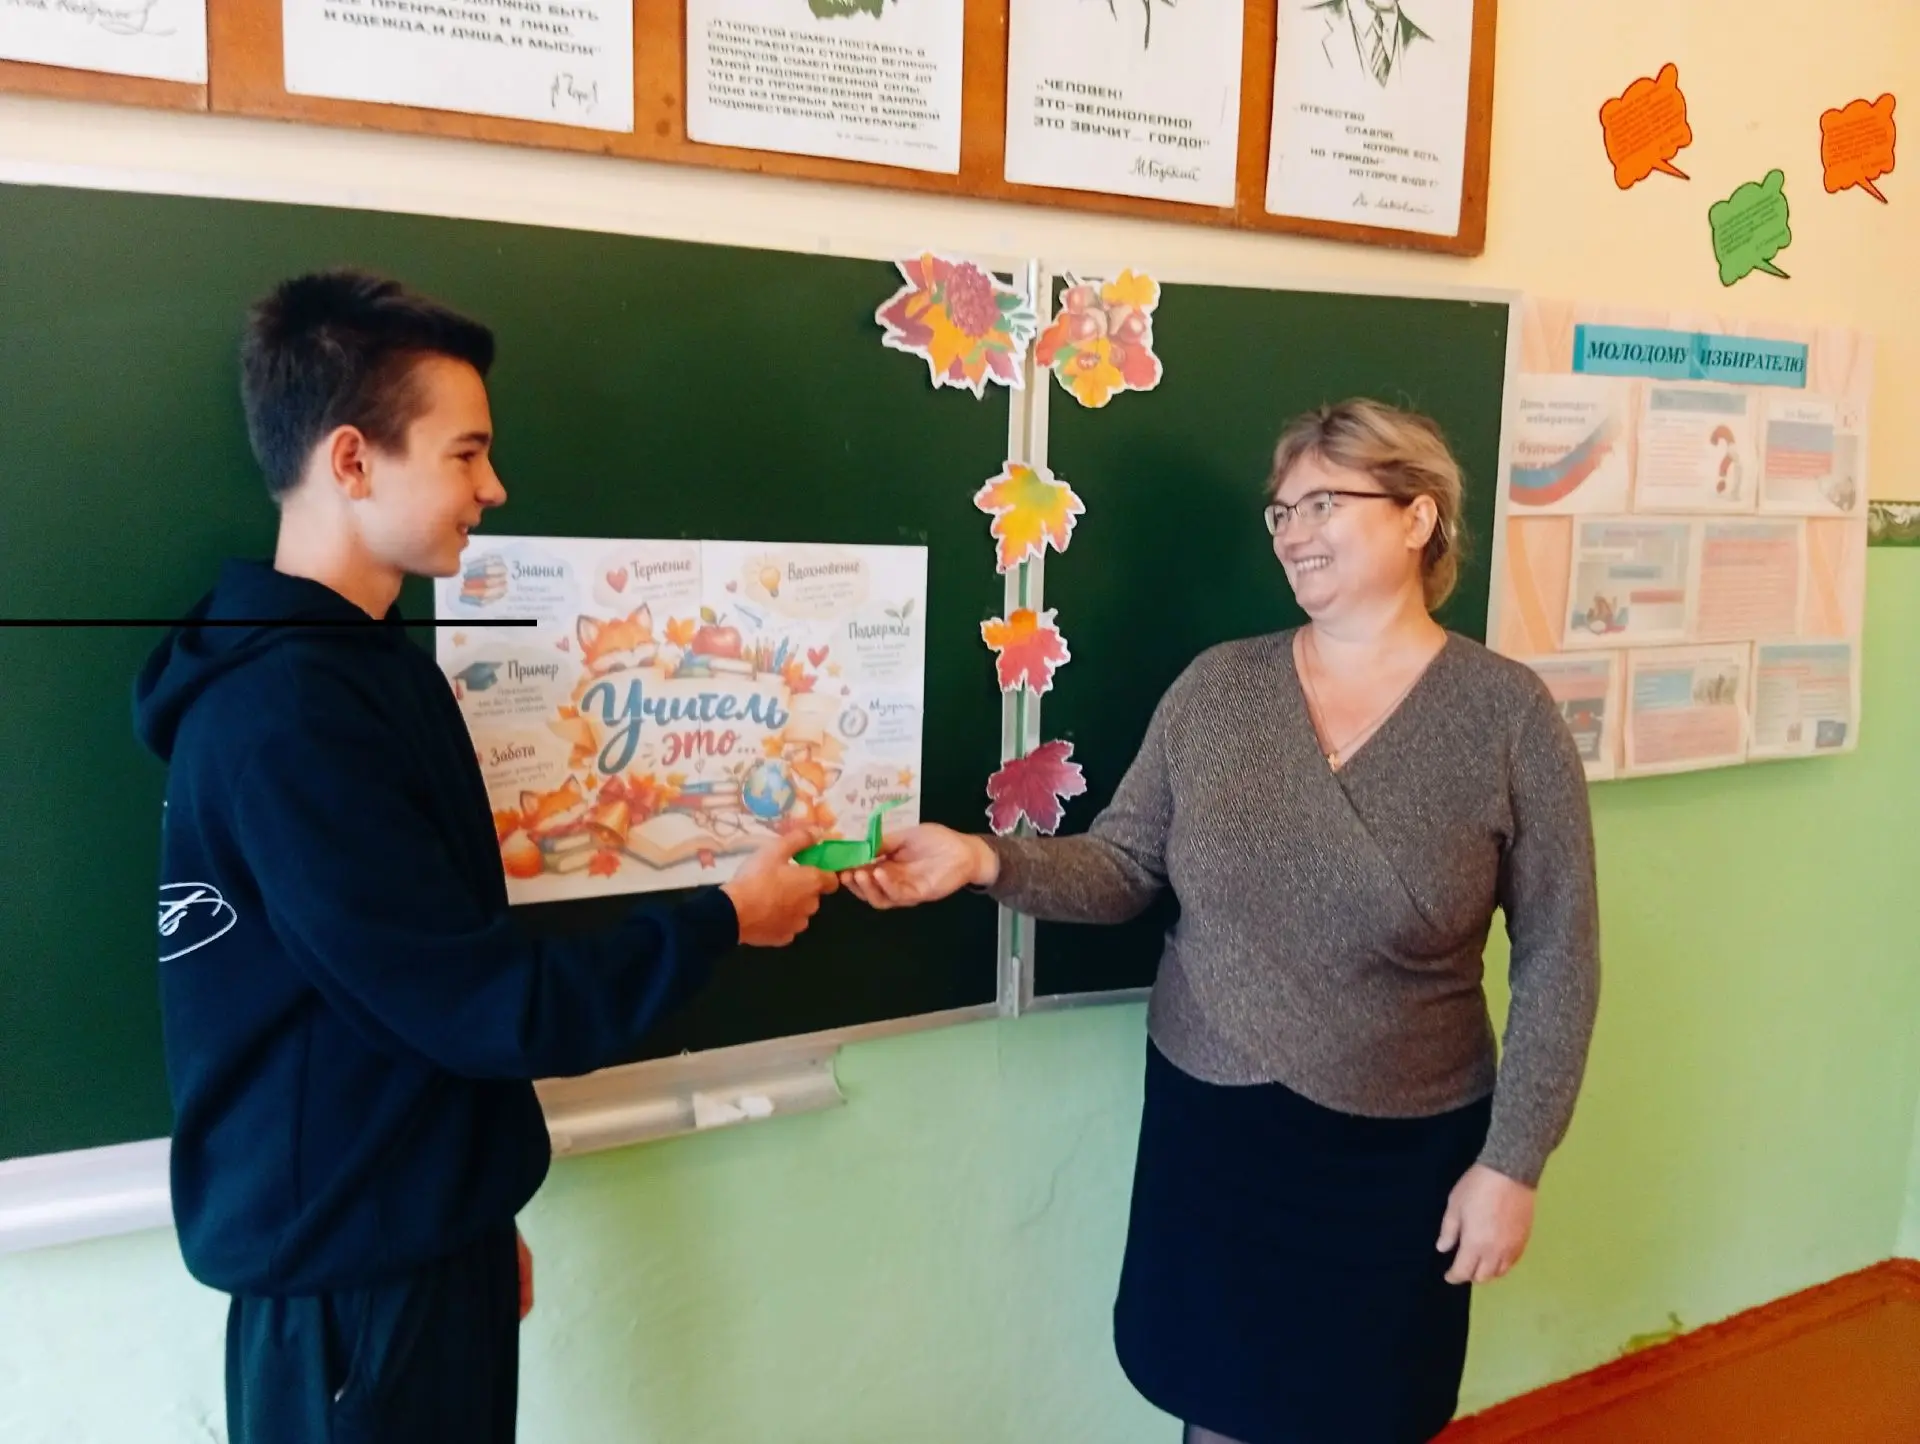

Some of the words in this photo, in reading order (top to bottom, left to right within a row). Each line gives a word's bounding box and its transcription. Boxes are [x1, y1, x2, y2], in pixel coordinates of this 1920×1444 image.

[499, 15, 512, 28] И
[548, 4, 599, 21] БЫТЬ
[323, 9, 337, 21] И
[432, 24, 445, 35] И
[511, 36, 523, 48] И
[1034, 115, 1065, 130] ЭТО
[1310, 147, 1326, 158] НО
[1586, 340, 1689, 366] МОЛОДОМУ
[1699, 347, 1805, 374] ИЗБИРАТЕЛЮ
[511, 560, 565, 580] Знания
[630, 558, 692, 580] Терпение
[787, 559, 861, 583] Вдохновение
[849, 620, 911, 641] Поддержка
[508, 659, 559, 683] Пример
[581, 678, 790, 776] Учитель
[490, 742, 536, 768] Забота
